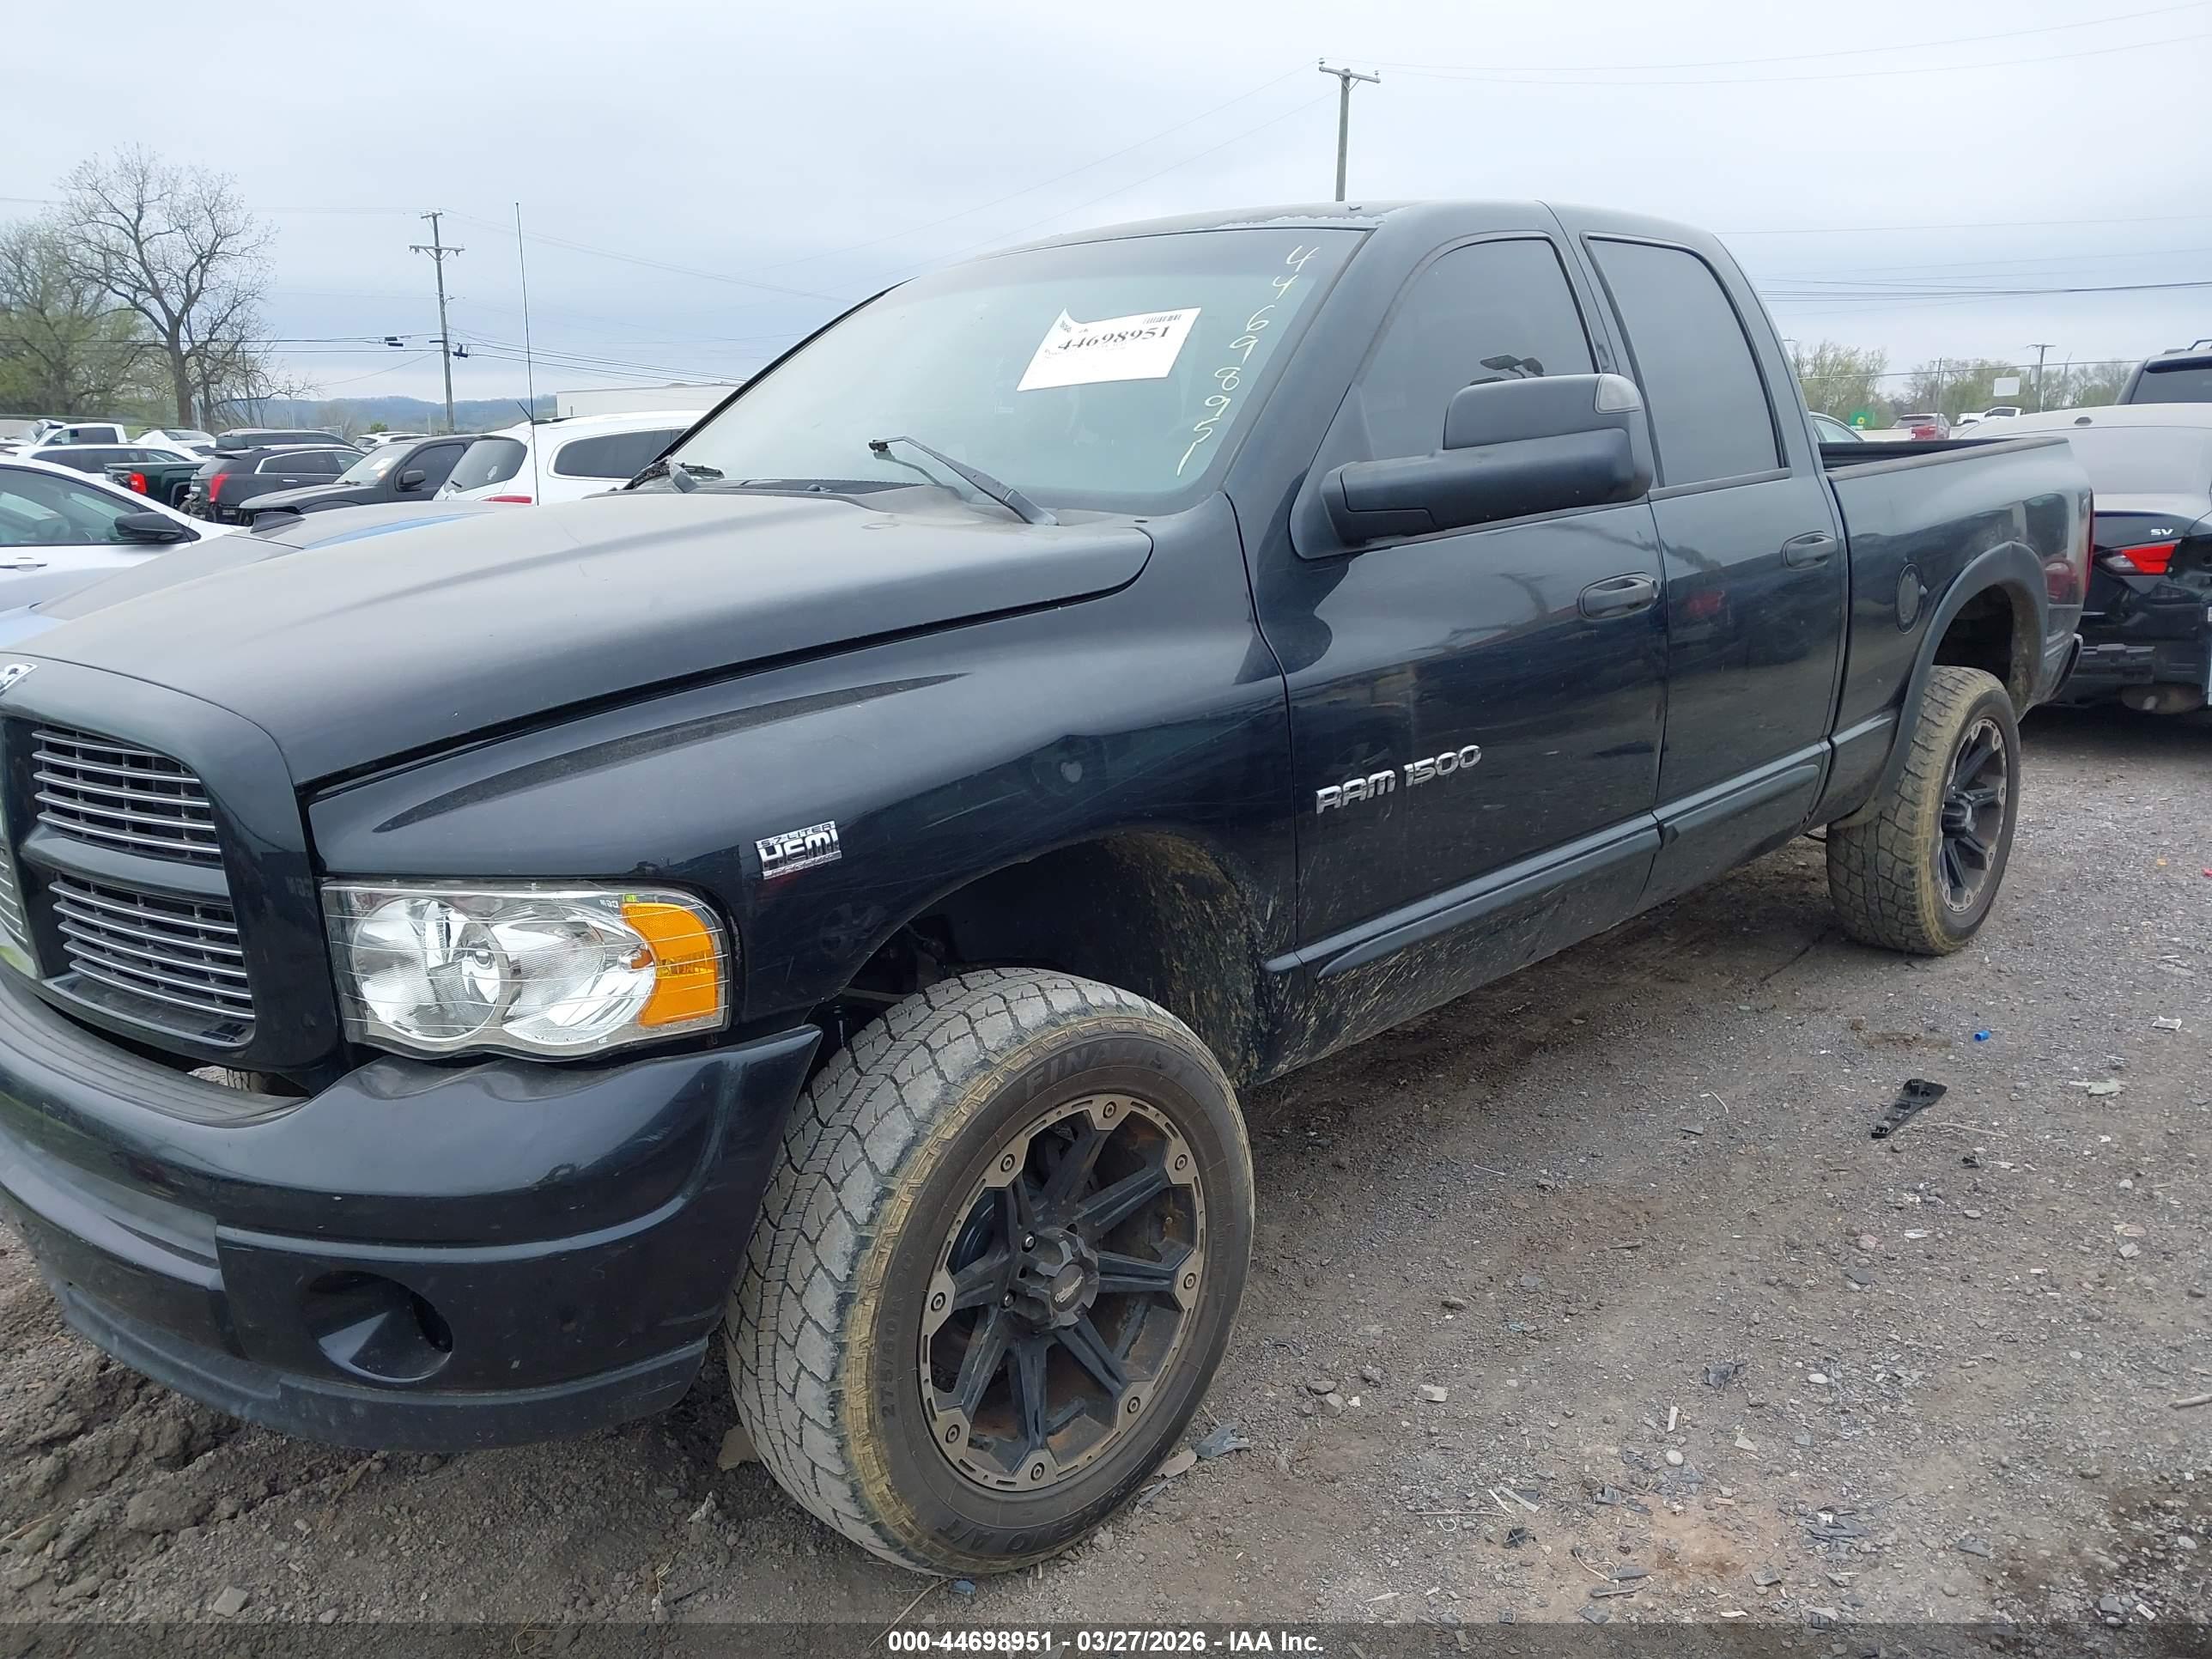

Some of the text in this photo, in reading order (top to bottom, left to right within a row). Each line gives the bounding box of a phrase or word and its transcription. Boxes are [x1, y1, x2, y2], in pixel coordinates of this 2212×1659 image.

[1058, 325, 1170, 350] 44698951
[1316, 744, 1482, 814] RAM 1500
[787, 823, 833, 840] LITER
[758, 829, 840, 872] HEMI
